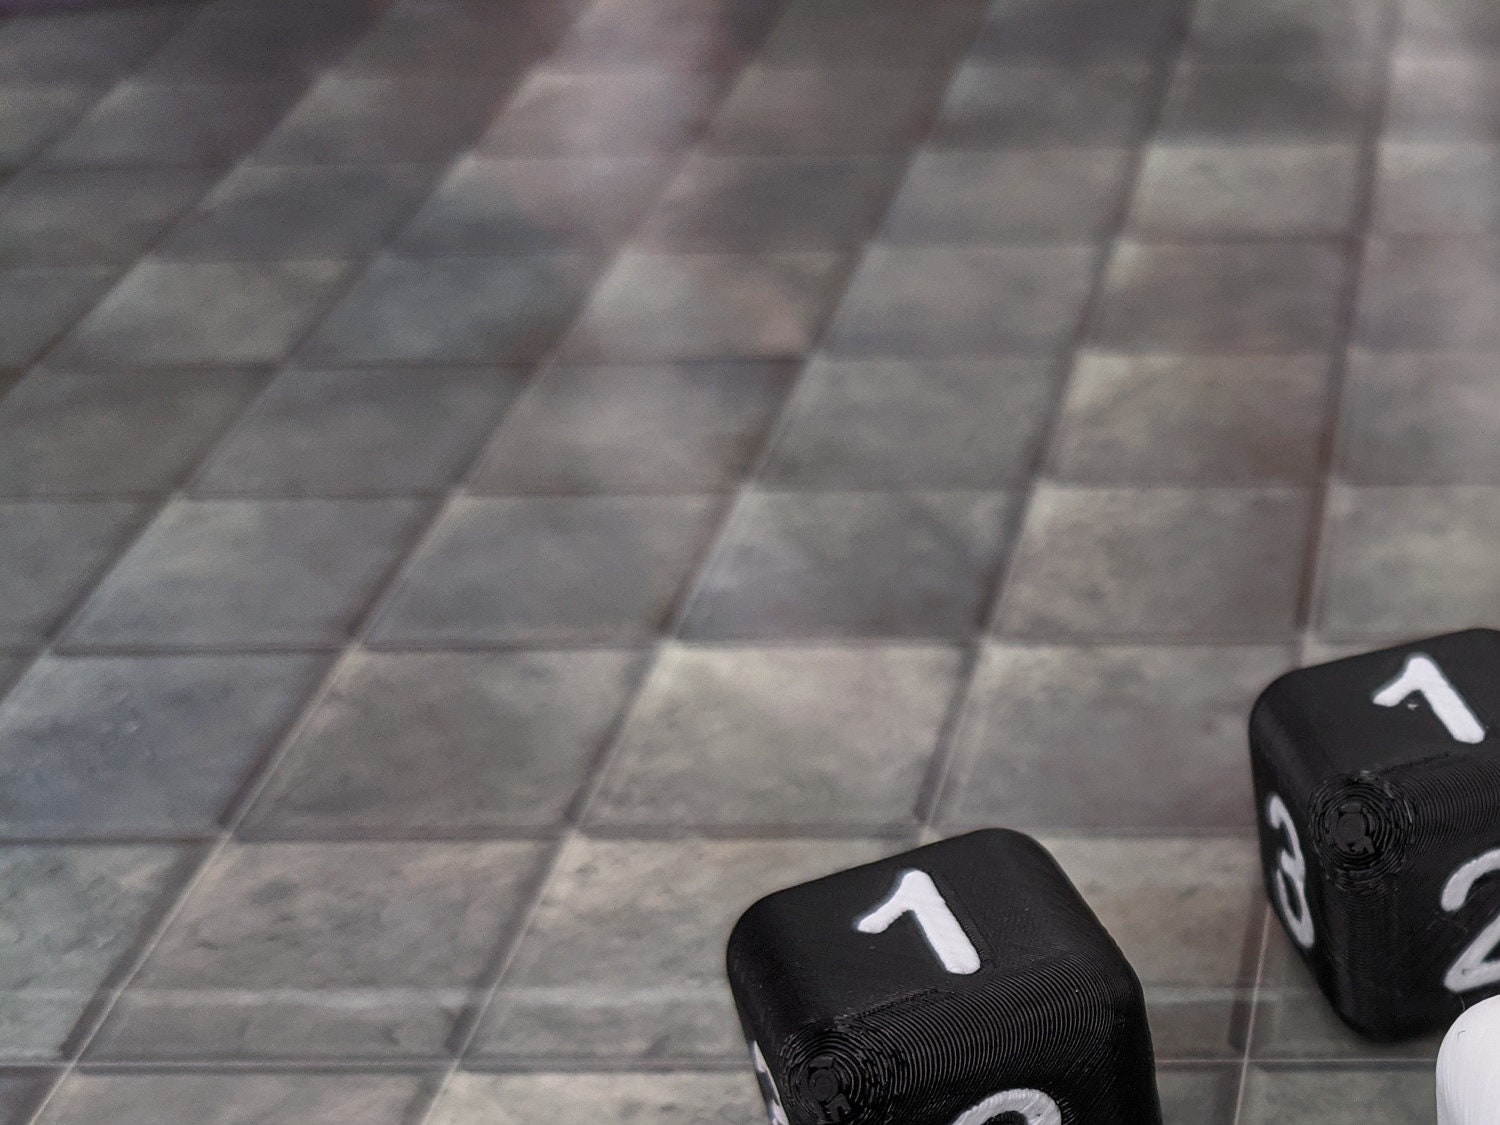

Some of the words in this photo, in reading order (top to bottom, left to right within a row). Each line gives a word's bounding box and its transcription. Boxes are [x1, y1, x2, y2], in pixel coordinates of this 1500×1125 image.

[1372, 654, 1486, 745] 1
[855, 868, 982, 976] 1
[1267, 794, 1315, 948] 3
